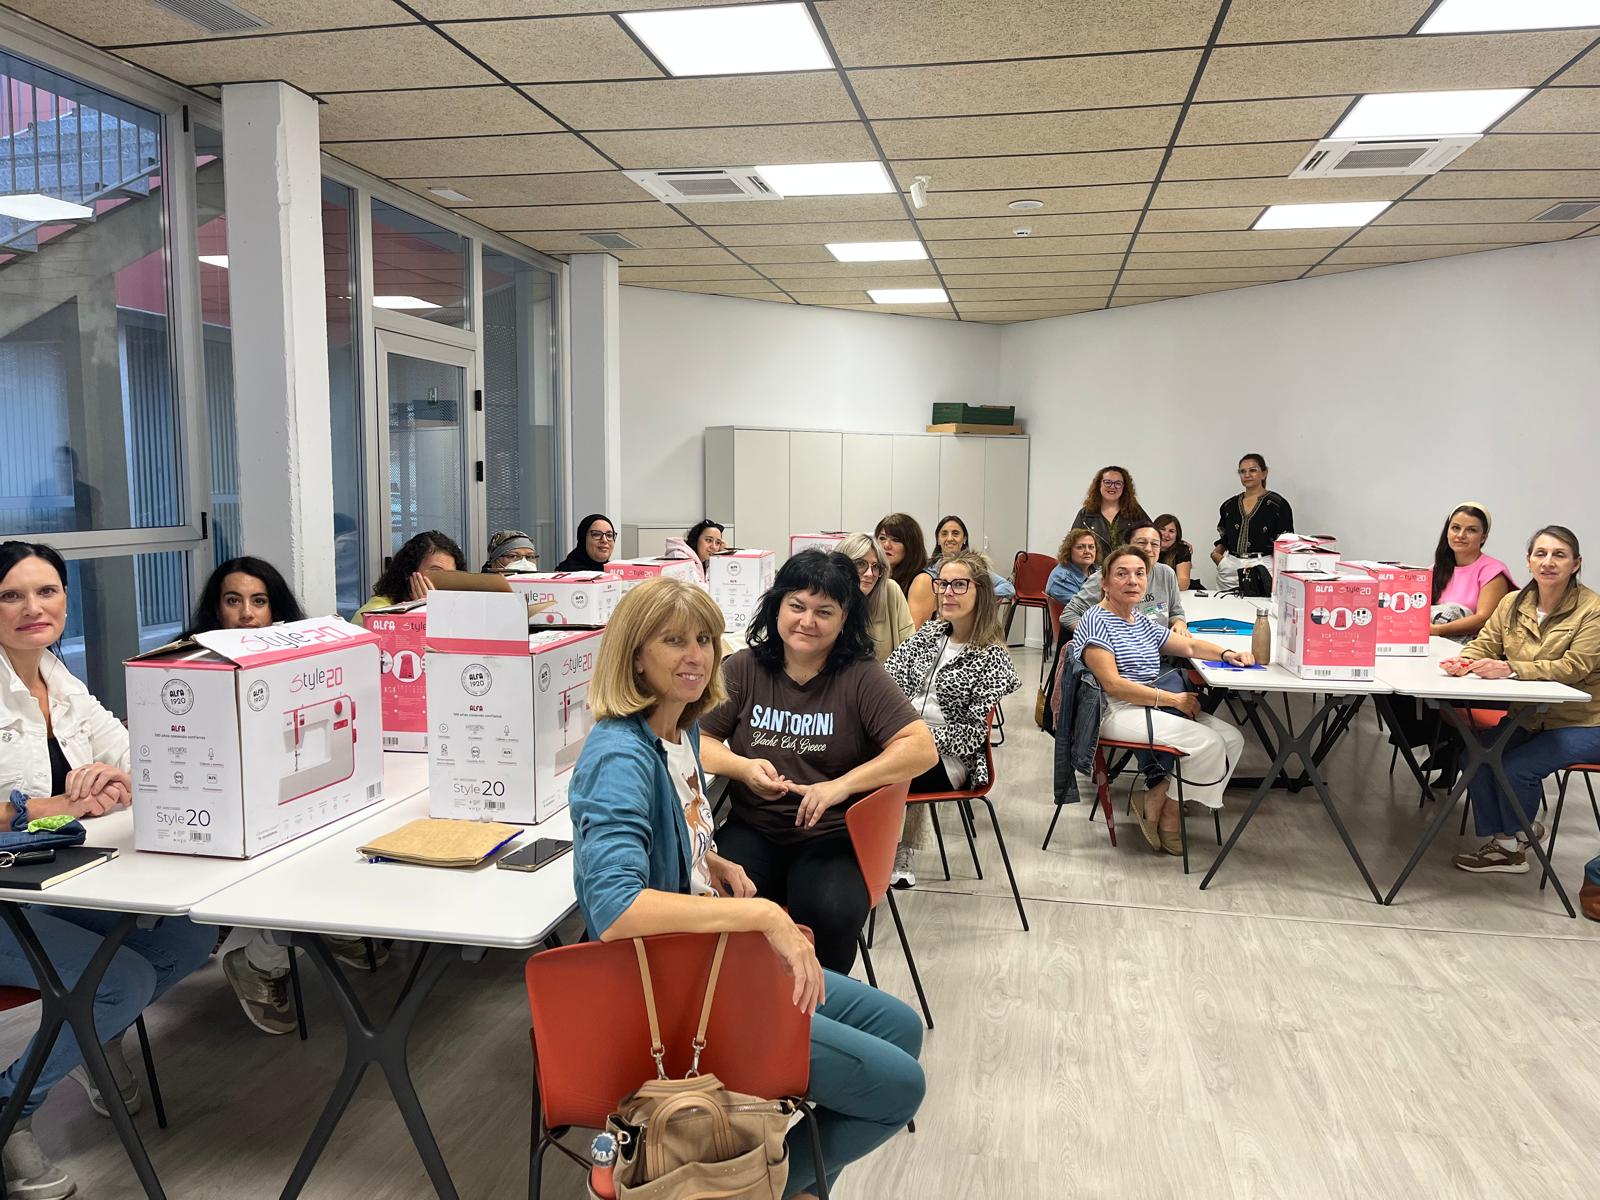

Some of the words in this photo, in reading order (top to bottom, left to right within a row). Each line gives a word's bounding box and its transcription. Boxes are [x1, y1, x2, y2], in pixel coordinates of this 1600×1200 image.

[1315, 585, 1334, 593] ALFA
[373, 620, 396, 631] ALFA
[401, 621, 427, 633] Style
[469, 673, 484, 681] ALFA
[470, 680, 485, 688] 1920
[169, 689, 185, 698] ALFA
[170, 697, 186, 705] 1920
[469, 704, 484, 712] ALFA
[749, 704, 833, 736] SANTORINI
[170, 724, 186, 733] ALFA
